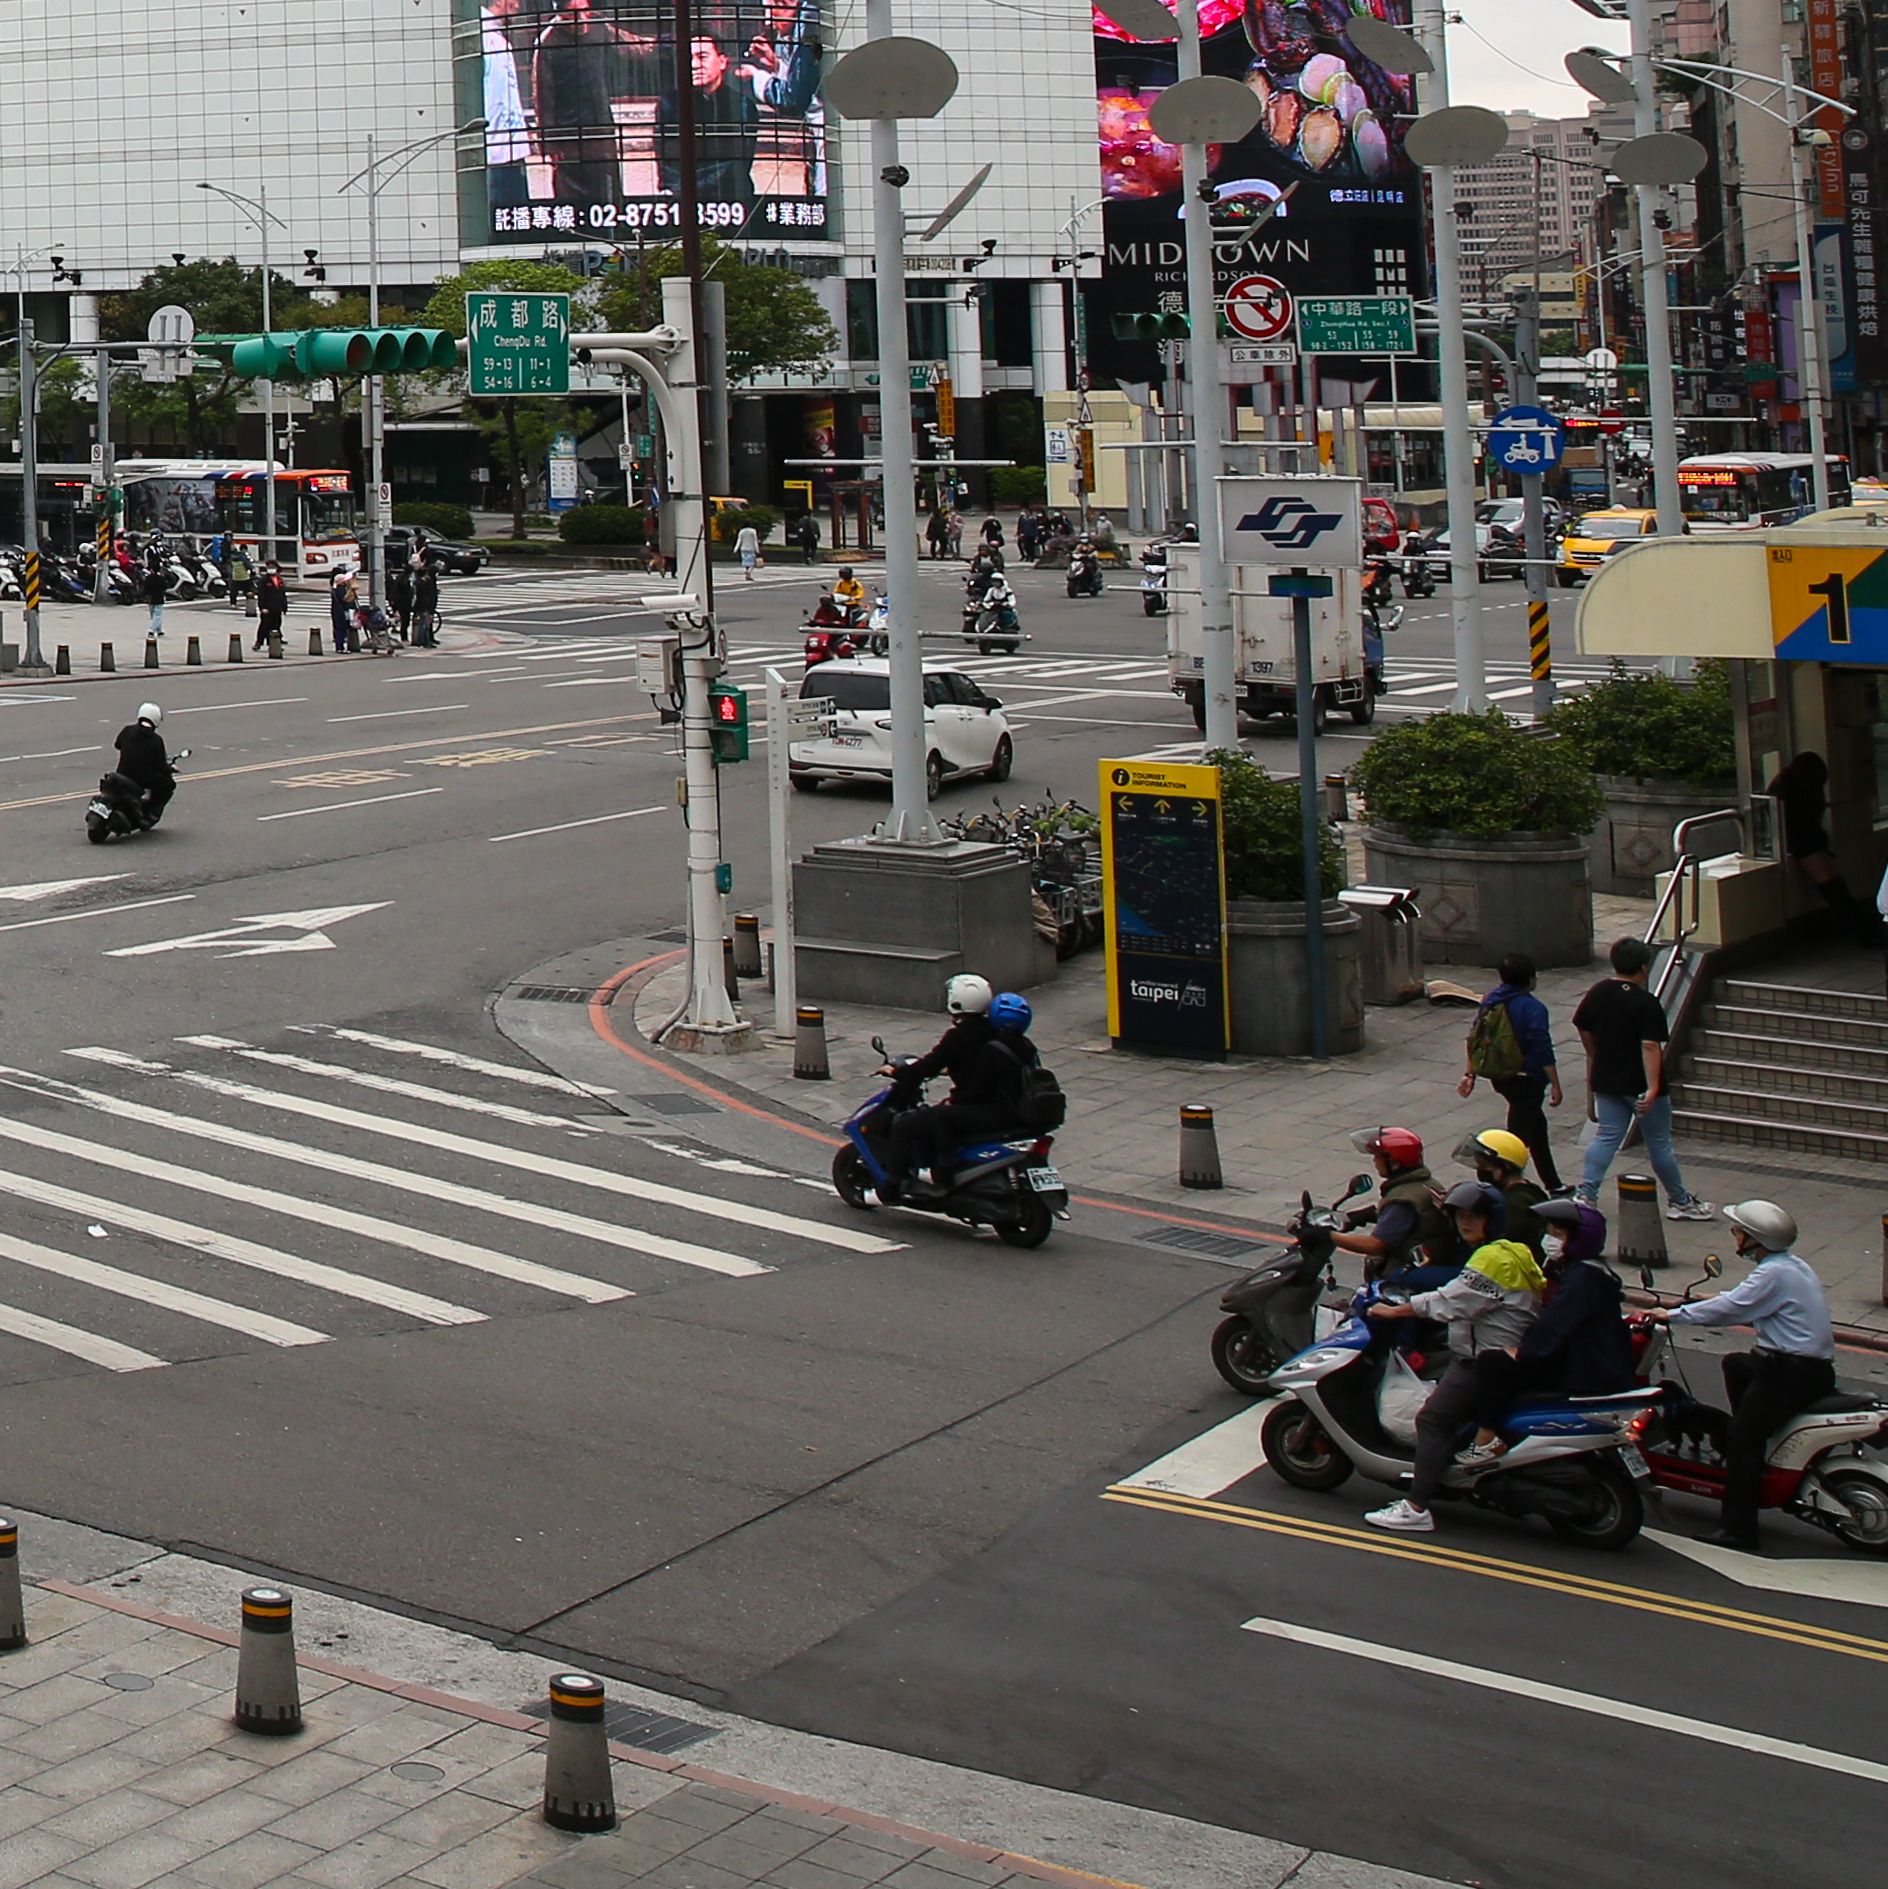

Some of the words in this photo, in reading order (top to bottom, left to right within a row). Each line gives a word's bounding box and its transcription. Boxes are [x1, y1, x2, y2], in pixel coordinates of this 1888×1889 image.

[494, 207, 586, 232] 託播專線:
[1108, 239, 1311, 267] MIDOWN
[479, 300, 560, 330] 成都路
[1311, 302, 1398, 316] 中華路一段
[494, 335, 530, 349] ChengDu
[534, 336, 548, 347] Rd.
[483, 358, 513, 371] 59-13
[530, 358, 551, 370] 11-1
[484, 376, 513, 389] 54-16
[531, 376, 552, 388] 6-4
[1808, 573, 1851, 644] 1
[1250, 660, 1274, 674] 1397
[1132, 772, 1166, 781] TOURIST
[1131, 779, 1187, 790] INFORMATION
[1130, 979, 1179, 1003] taipei
